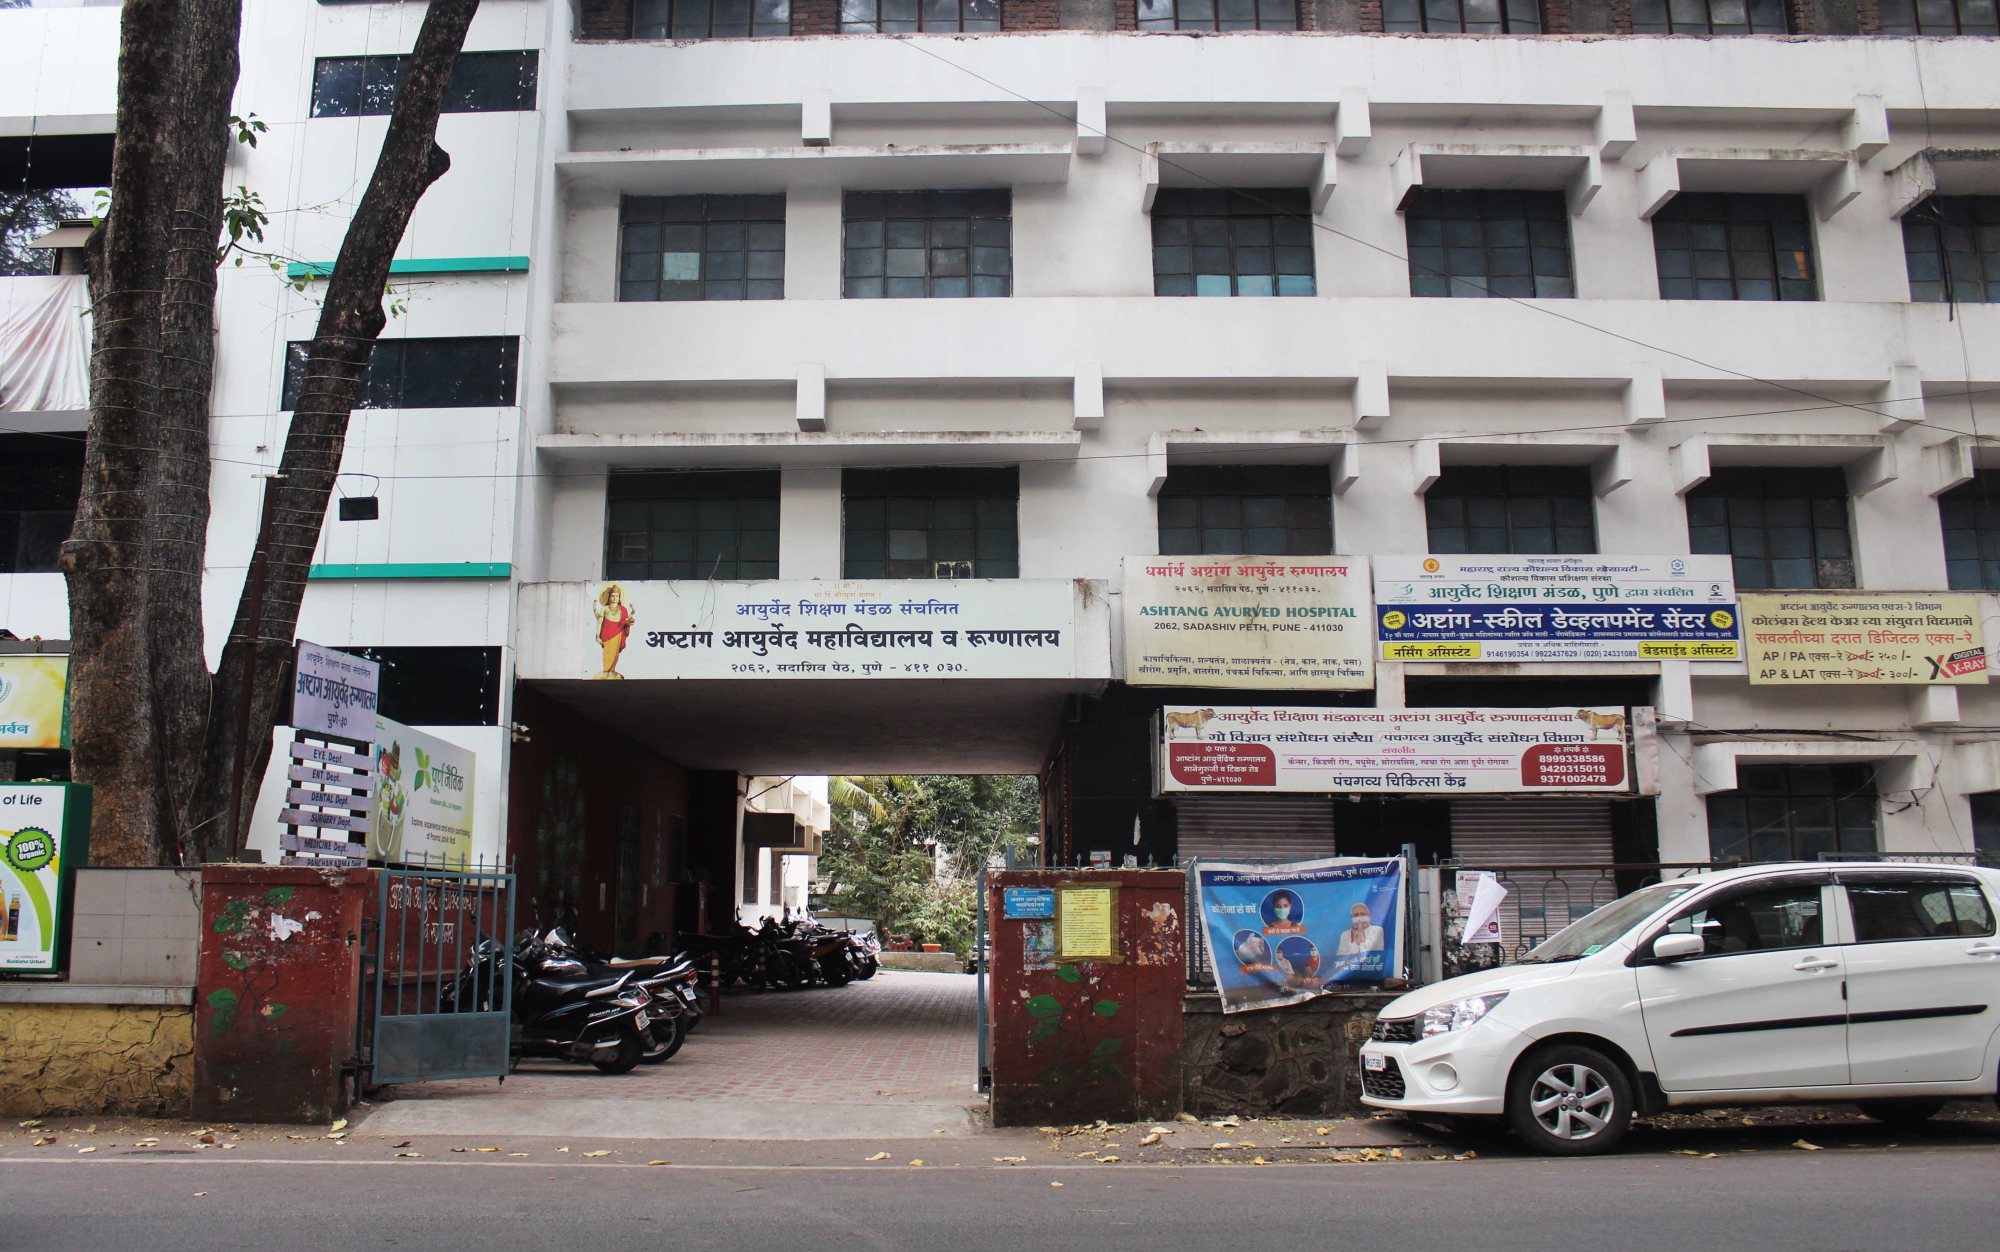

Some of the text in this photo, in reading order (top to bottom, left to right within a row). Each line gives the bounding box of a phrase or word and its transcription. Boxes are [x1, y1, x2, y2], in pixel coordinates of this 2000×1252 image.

[1145, 562, 1348, 581] धर्मार्थ अष्टांग आयुर्वेद रुग्णालय
[1206, 584, 1237, 594] सदाशिव
[1240, 584, 1254, 594] पेठ,
[1256, 584, 1270, 596] पुणे
[1428, 584, 1482, 602] आयुर्वेद
[1488, 584, 1536, 600] शिक्षण
[1542, 584, 1586, 600] मंडळ,
[1592, 584, 1619, 602] पुणे
[736, 599, 960, 620] आयुर्वेद शिक्षण मंडळ संचलित
[1139, 606, 1358, 618] ASHTANG AYURVED HOSPITAL
[1810, 602, 1838, 613] आयुर्वेद
[1914, 602, 1942, 612] विभाग
[1412, 607, 1706, 629] अष्टांग-स्कील डेव्हलपमेंट सेंटर
[1752, 614, 1974, 628] कोलंबस हेल्थ केअर च्या संयुक्त विद्यमाने
[1154, 622, 1344, 633] 2062, SADASHIV PETH, PUNE 411030
[646, 624, 713, 650] अष्टांग
[722, 623, 798, 656] आयुर्वेद
[806, 622, 934, 651] महाविद्यालय
[941, 631, 958, 648] व
[1756, 630, 1974, 645] सवलतीच्या दरात डिजिटल एक्स-रे
[1393, 645, 1472, 658] नर्सिंग असिस्टंट
[1583, 650, 1602, 658] (020)
[1642, 643, 1734, 657] बेडसाईड असिस्टंट
[1762, 652, 1780, 662] AP
[1790, 652, 1806, 662] PA
[1809, 650, 1842, 662] एक्स-रे
[1952, 648, 1984, 660] DIGITAL
[731, 661, 968, 676] २०६२, सदाशिव पेठ, पुणे ४११ ०३०.
[1302, 658, 1320, 667] कान,
[1322, 658, 1341, 667] नाक,
[1952, 658, 1986, 673] X-RAY
[1289, 668, 1308, 677] आणि
[1760, 670, 1776, 680] AP
[1780, 670, 1789, 680] &
[1793, 670, 1816, 680] LAT
[1820, 667, 1854, 680] एक्स-रे
[297, 670, 376, 712] अष्टांग आयुर्वेद रुग्णालय
[1218, 710, 1573, 724] आयुर्वेद शिक्षण मंडळाच्या अष्टांग आयुर्वेद रुग्णालयाचा
[1208, 731, 1226, 742] गो
[1230, 730, 1270, 744] विज्ञान
[1276, 732, 1328, 743] संशोधन
[1432, 732, 1484, 746] आयुर्वेद
[1488, 732, 1540, 743] संशोधन
[1544, 732, 1584, 743] विभाग
[1338, 758, 1352, 766] रोग,
[1440, 758, 1451, 766] रोग
[1538, 754, 1606, 764] 8999338586
[1540, 764, 1606, 774] 9420315019
[326, 773, 342, 784] Dept.
[1333, 772, 1467, 788] पंचगव्य चिकित्सा केंद्र
[1540, 774, 1607, 784] 9371002478
[4, 792, 43, 806] of Life
[311, 792, 334, 804] DENTAL
[310, 813, 336, 826] SURGERY
[17, 839, 44, 853] 100%
[304, 838, 332, 850] MEDICINE
[19, 849, 46, 860] Organic
